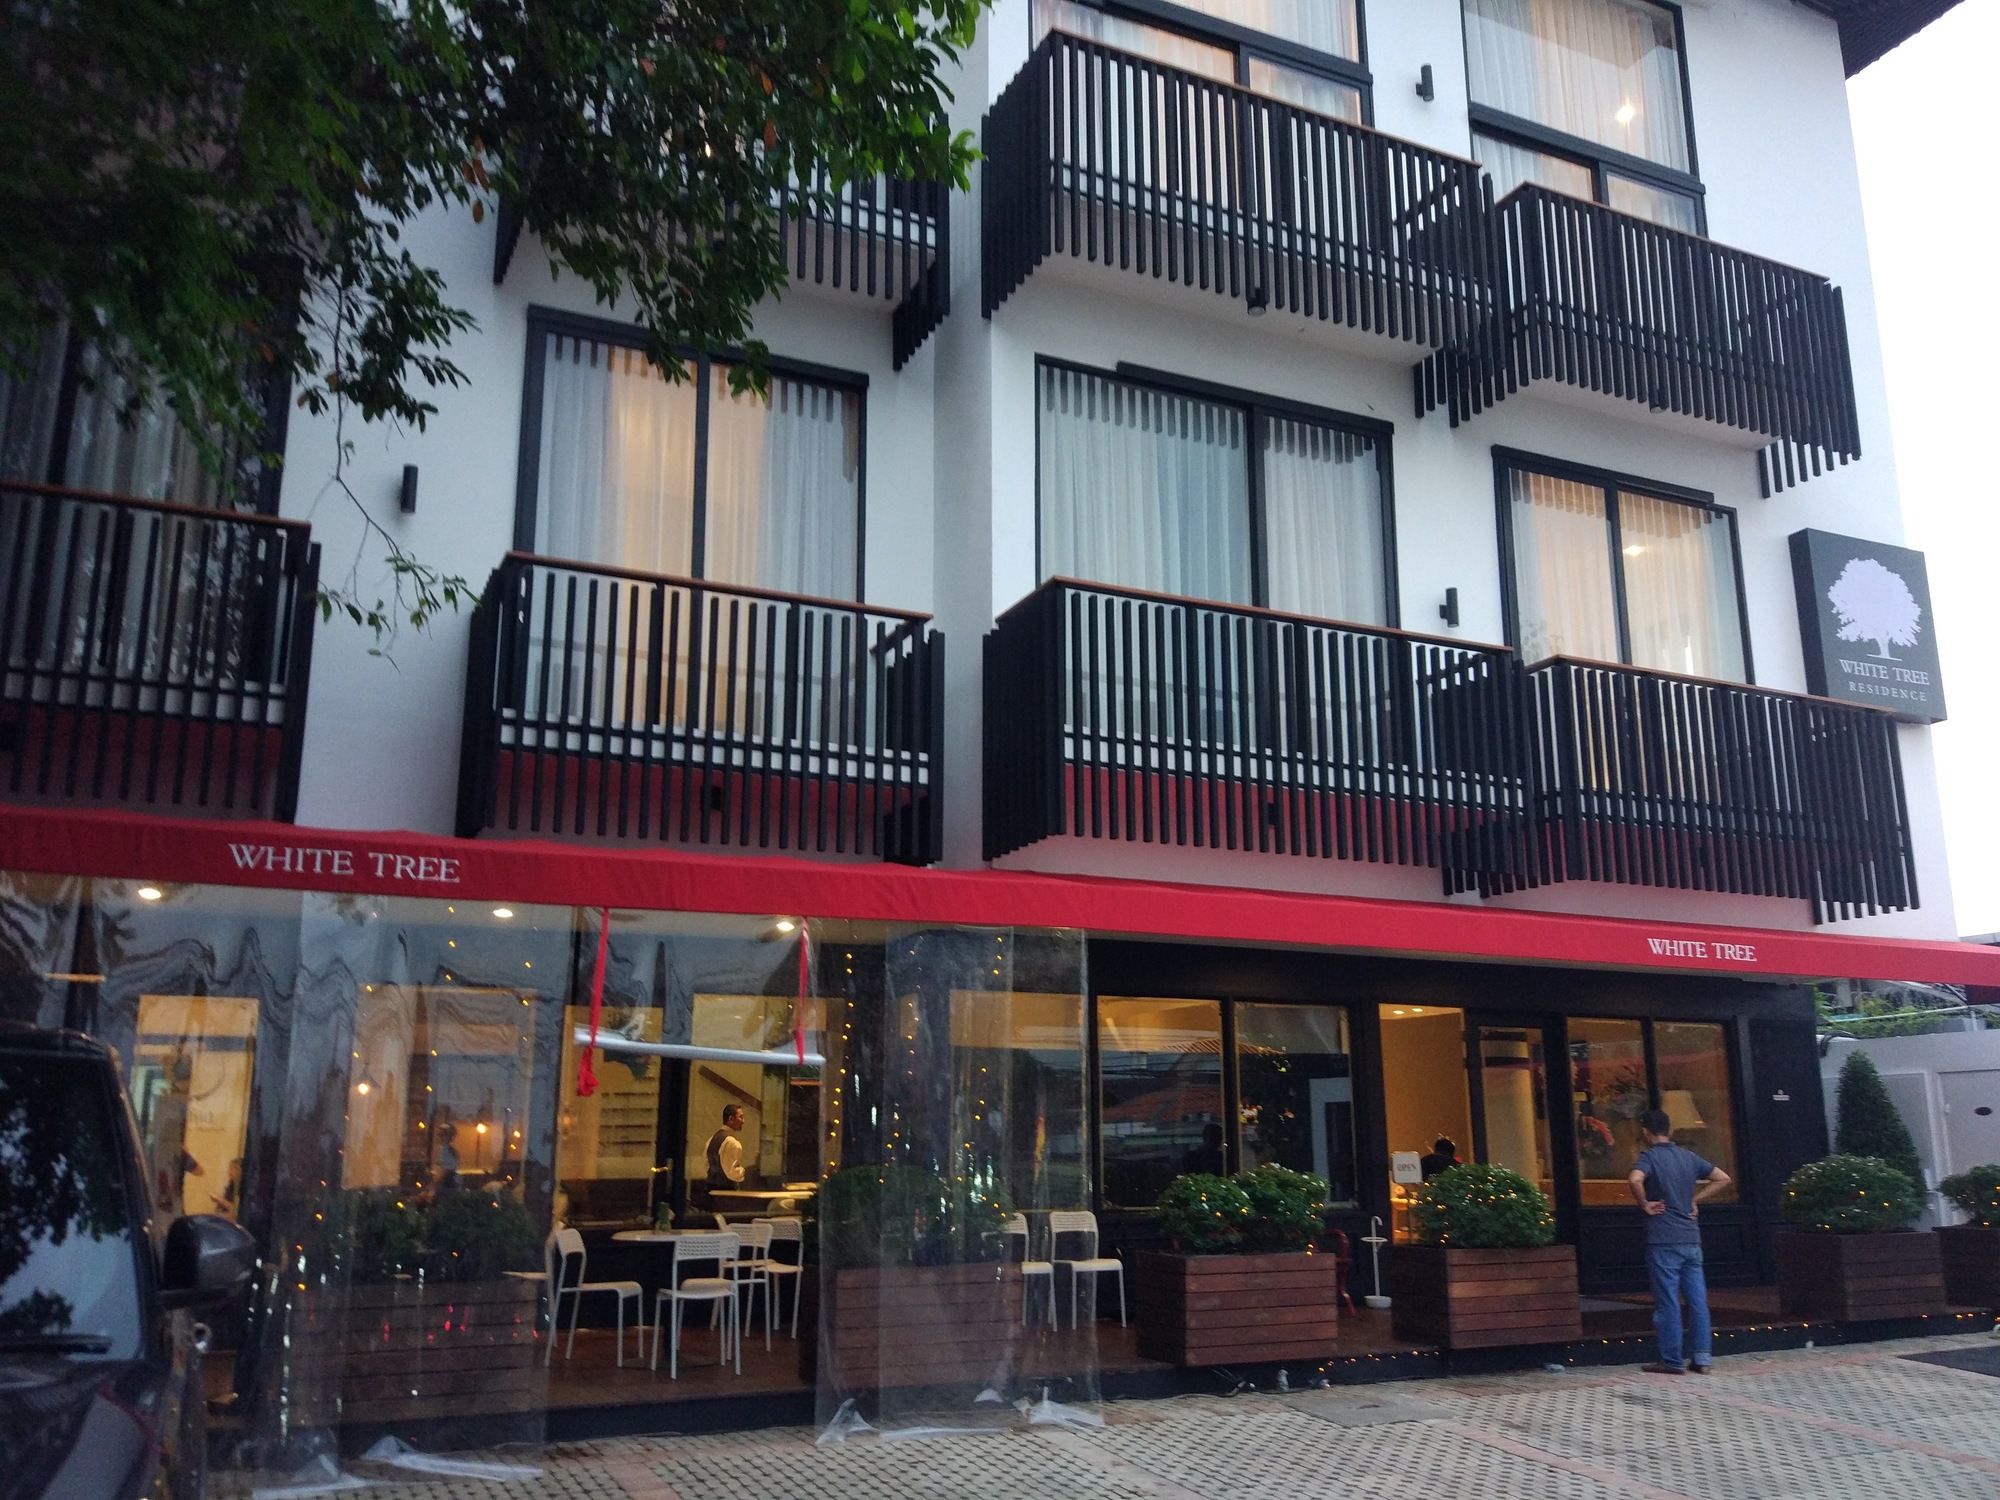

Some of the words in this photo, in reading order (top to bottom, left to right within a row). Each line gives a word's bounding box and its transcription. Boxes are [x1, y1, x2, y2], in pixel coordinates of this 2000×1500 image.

[1839, 659, 1889, 680] WHITE
[1892, 667, 1930, 686] TREE
[1848, 681, 1928, 702] RESIDENCE
[228, 842, 355, 875] WHITE
[368, 852, 460, 884] TREE
[1647, 938, 1708, 958] WHITE
[1711, 942, 1758, 962] TREE
